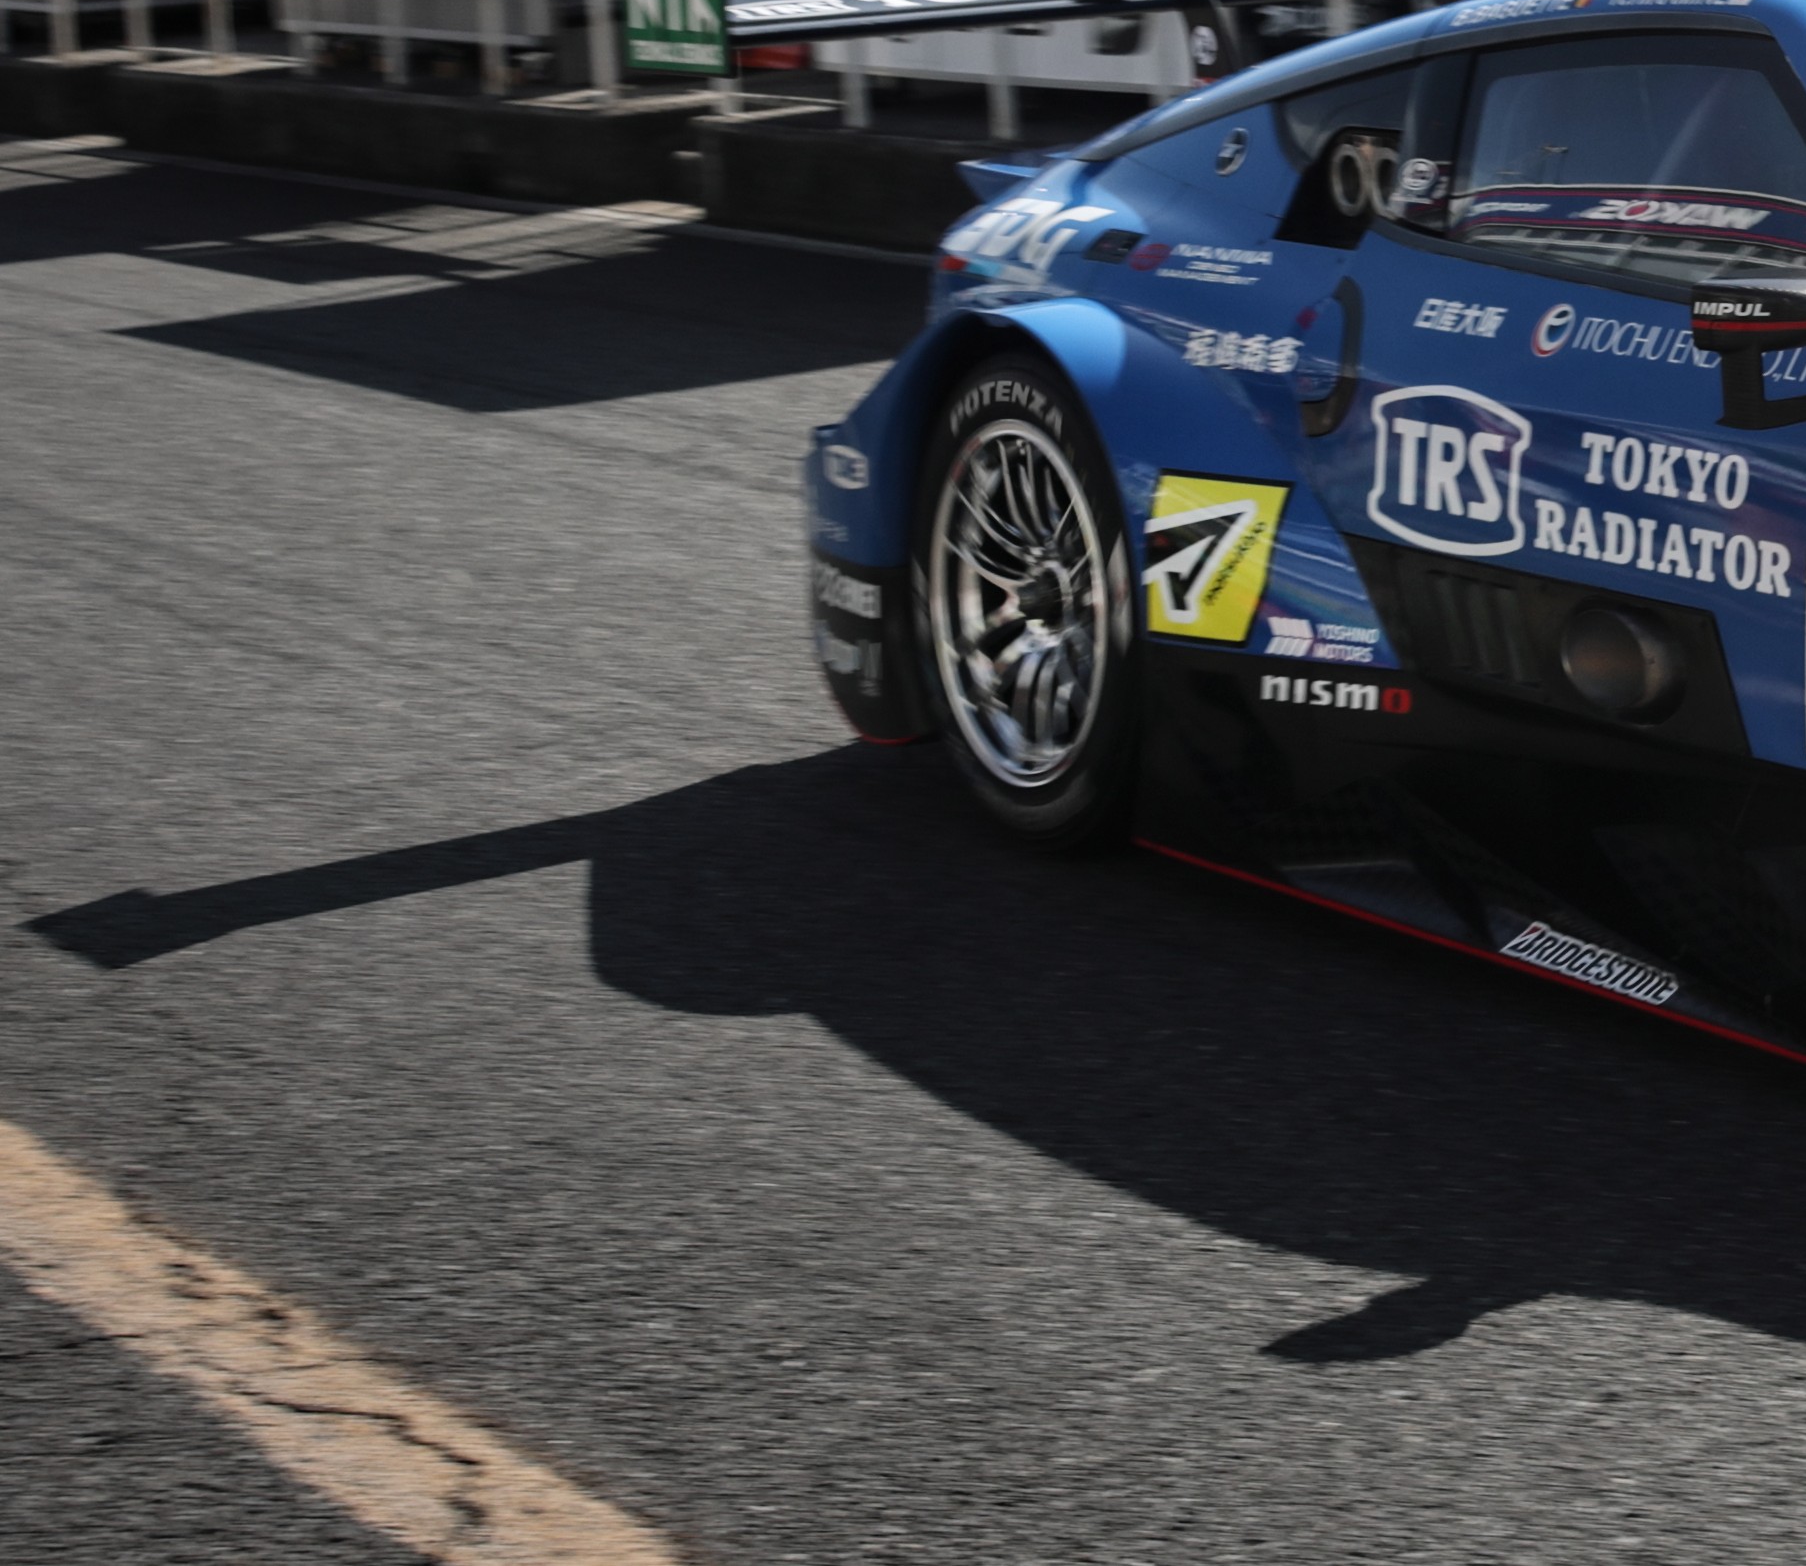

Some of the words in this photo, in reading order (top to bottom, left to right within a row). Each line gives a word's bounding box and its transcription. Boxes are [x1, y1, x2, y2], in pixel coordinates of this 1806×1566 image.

[1413, 298, 1508, 338] 日産大阪
[1572, 317, 1667, 362] ITOCHU
[1692, 300, 1772, 318] IMPUL
[1393, 417, 1507, 524] TRS
[1580, 431, 1751, 512] TOKYO
[1533, 499, 1792, 598] RADIATOR
[1260, 675, 1412, 715] nismo
[1498, 920, 1681, 1007] BRIDGESTONE
